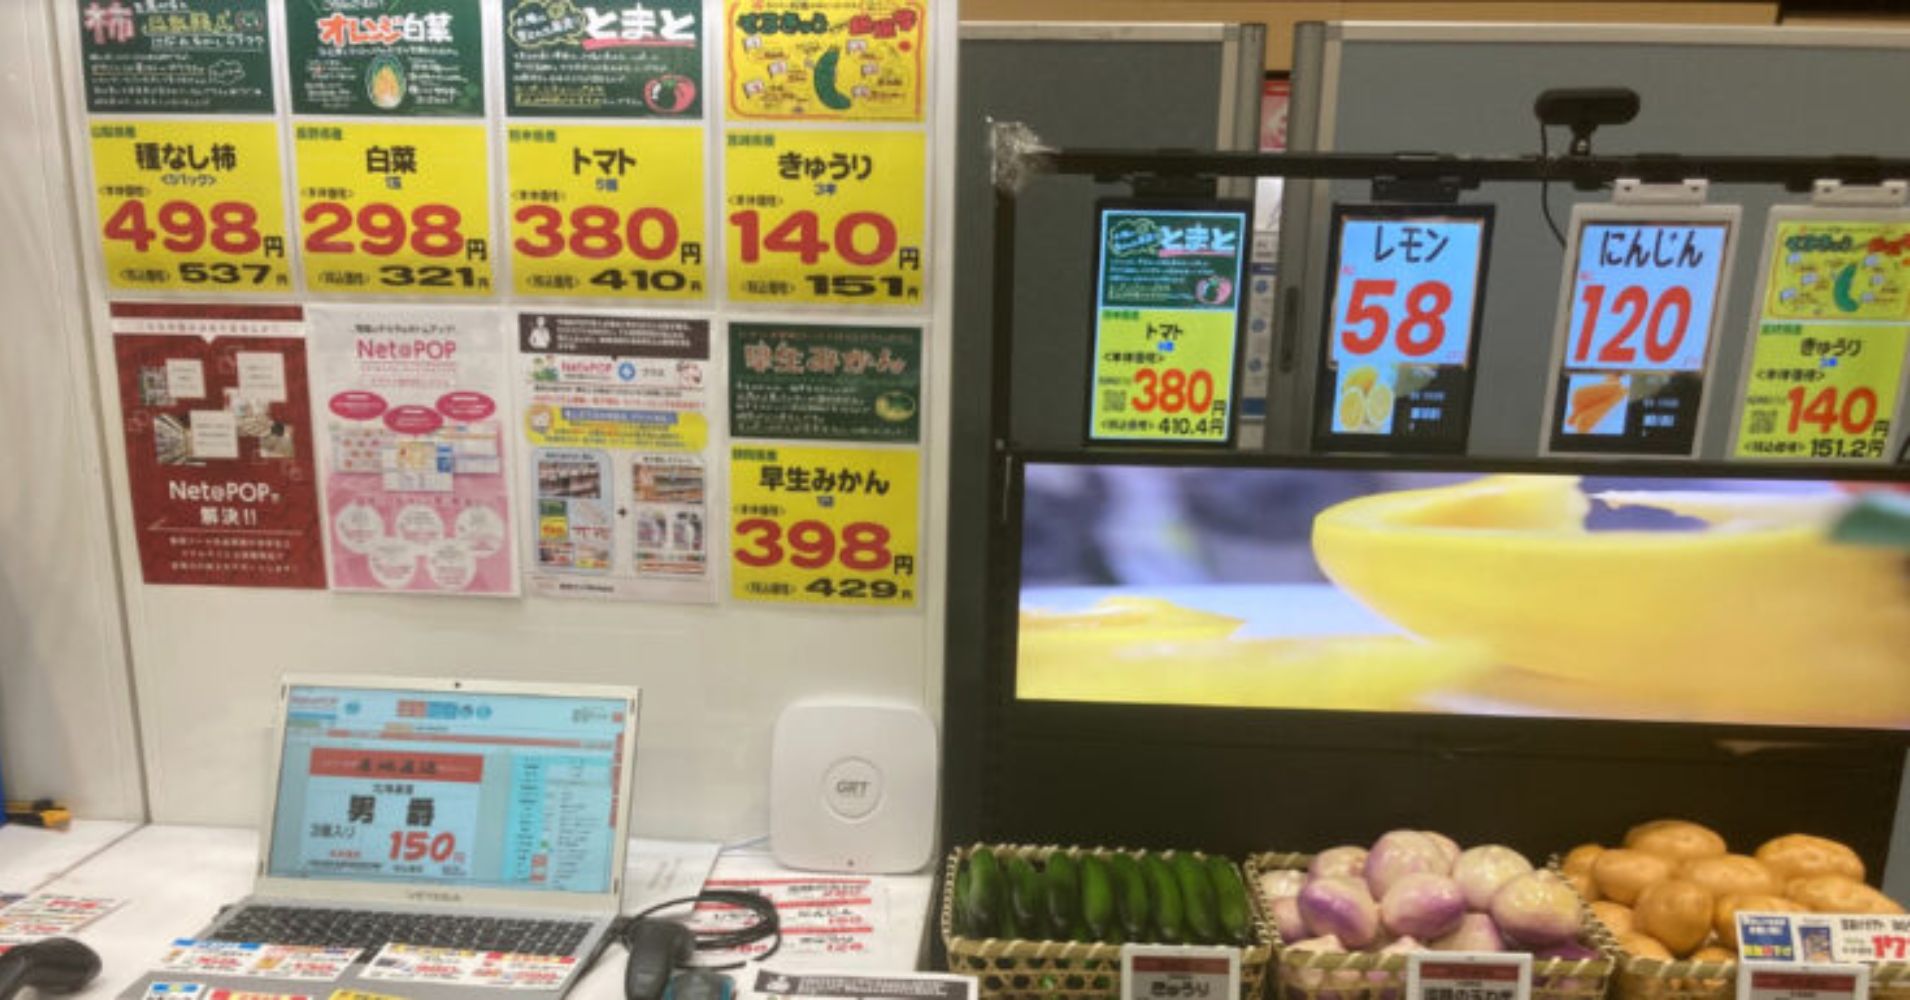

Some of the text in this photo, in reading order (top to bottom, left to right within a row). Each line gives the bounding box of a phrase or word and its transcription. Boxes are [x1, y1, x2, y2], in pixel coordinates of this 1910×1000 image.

[83, 1, 135, 45] 柿
[317, 12, 454, 48] オレンジ白菜
[584, 1, 696, 40] とまと
[135, 142, 237, 171] 種なし柿
[366, 145, 418, 174] 白菜
[573, 147, 637, 176] トマト
[777, 151, 873, 181] きゅうり
[1160, 222, 1236, 250] とまと
[1374, 225, 1450, 262] レモン
[1600, 228, 1703, 268] にんじん
[1146, 322, 1184, 340] トマト
[1341, 278, 1453, 357] 58
[1574, 284, 1692, 363] 120
[1801, 338, 1862, 356] きゅうり
[759, 465, 890, 495] 早生みかん
